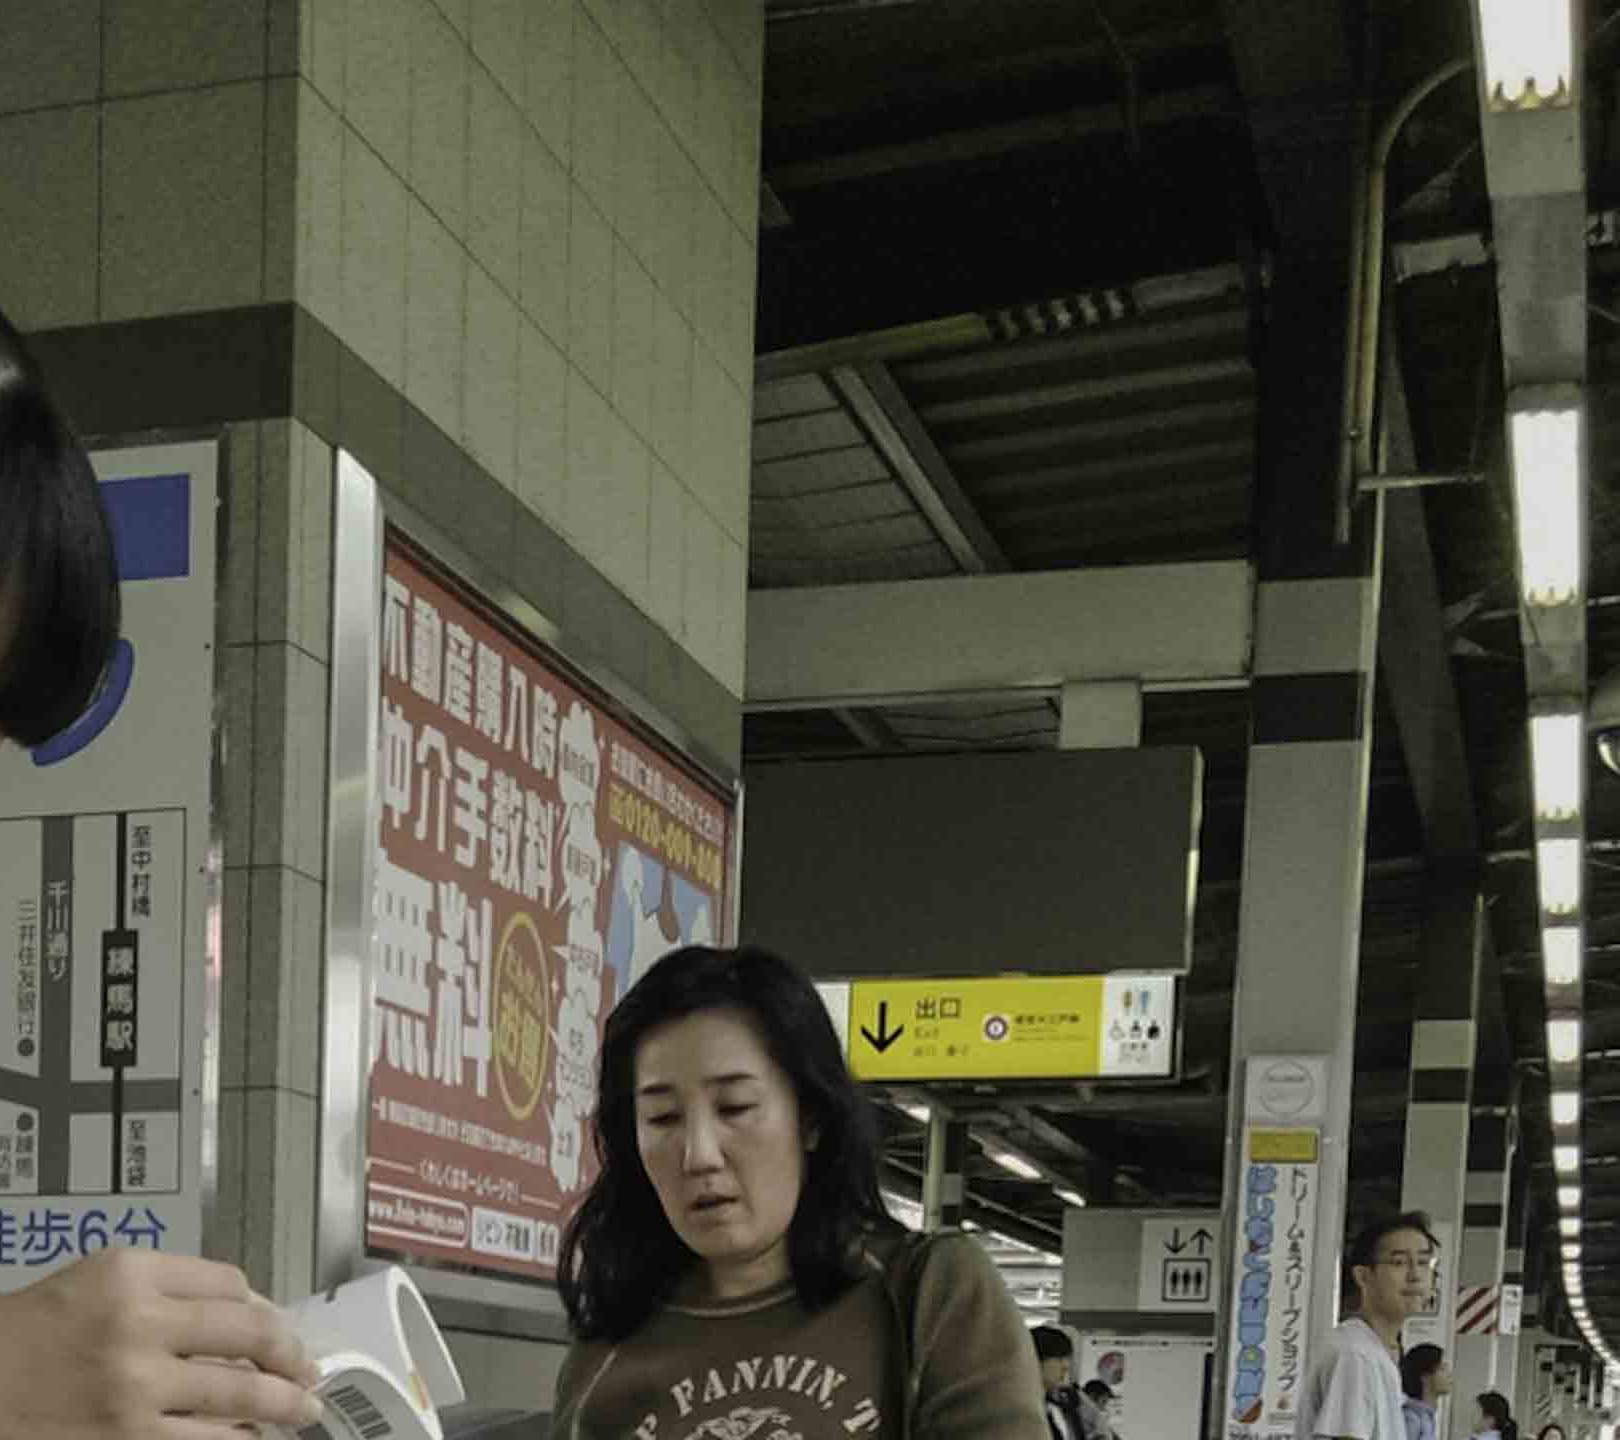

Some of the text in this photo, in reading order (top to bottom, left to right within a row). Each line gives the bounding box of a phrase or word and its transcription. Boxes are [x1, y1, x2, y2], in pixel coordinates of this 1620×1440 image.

[106, 946, 134, 1051] 練馬駅
[372, 848, 493, 1097] 無料
[915, 997, 962, 1020] 出口
